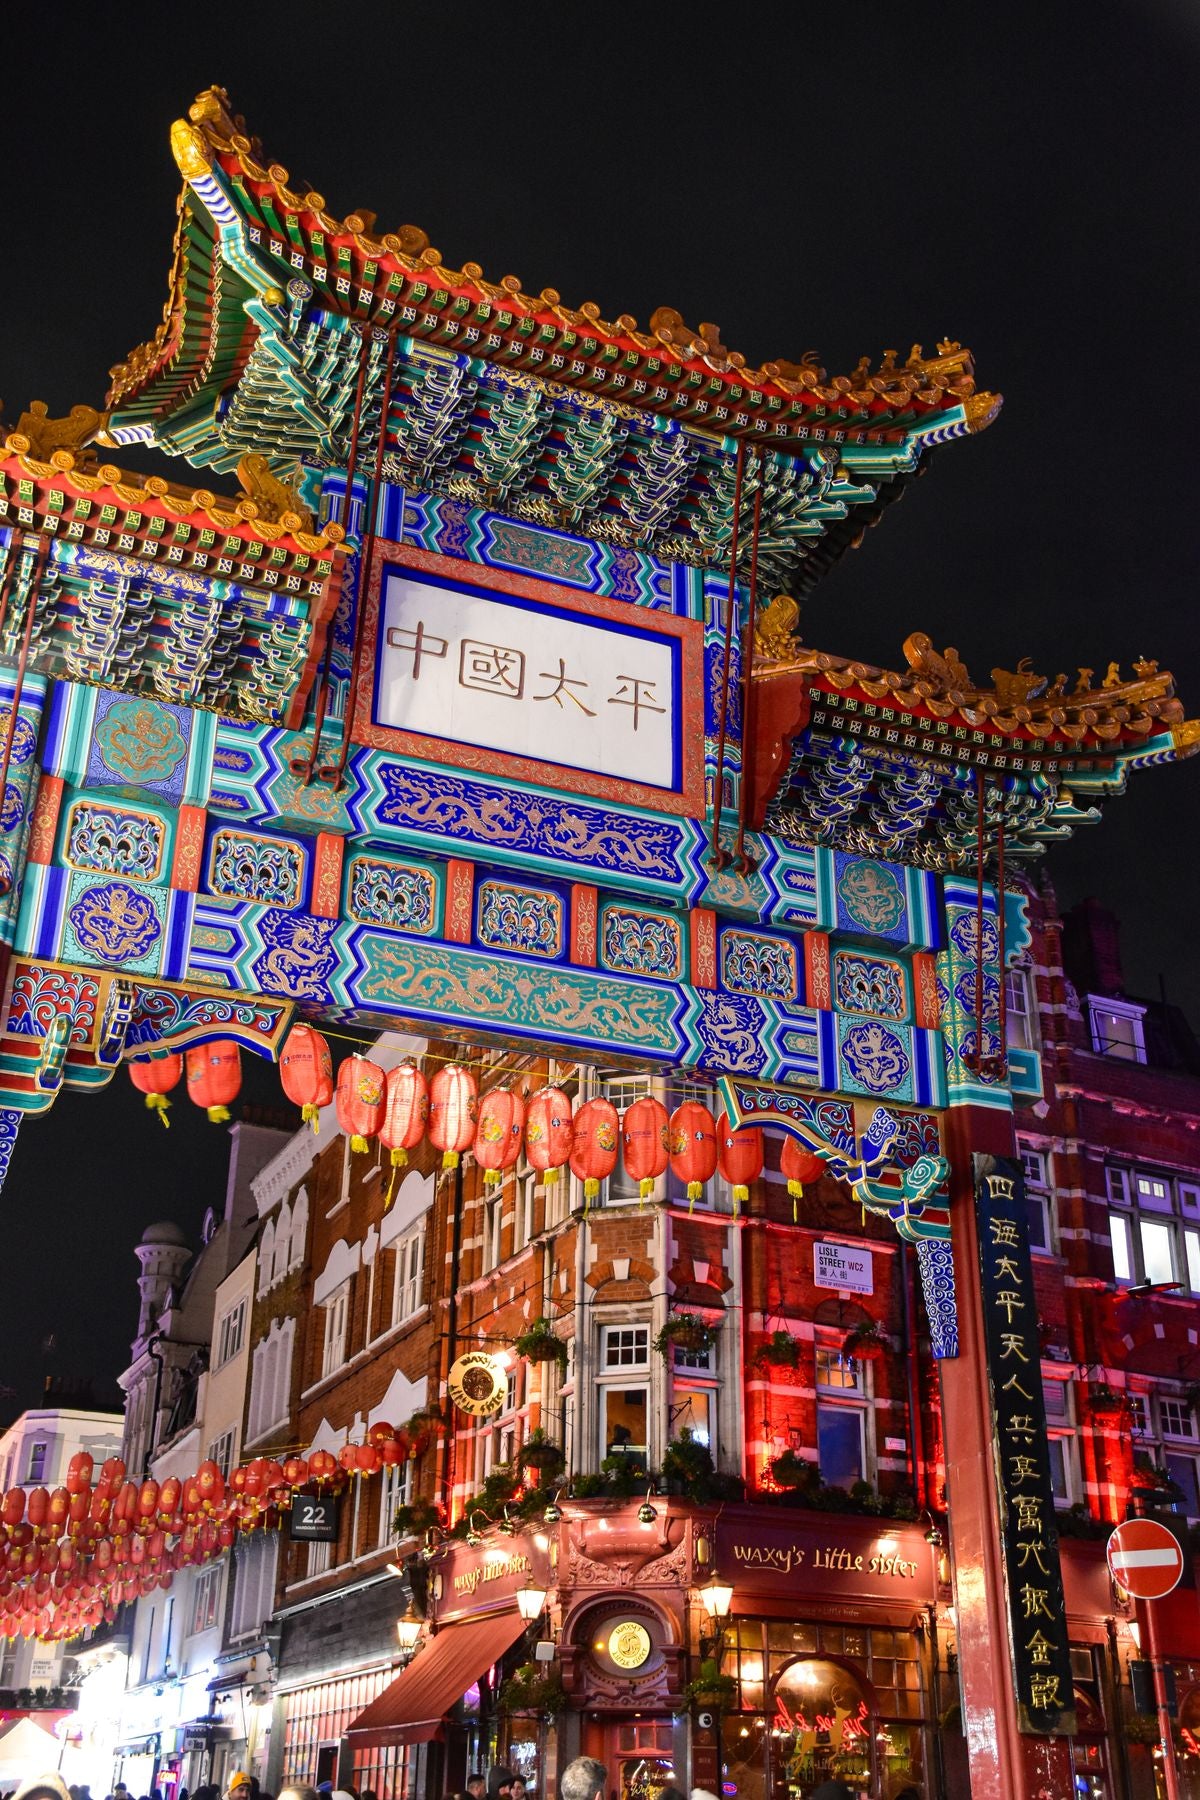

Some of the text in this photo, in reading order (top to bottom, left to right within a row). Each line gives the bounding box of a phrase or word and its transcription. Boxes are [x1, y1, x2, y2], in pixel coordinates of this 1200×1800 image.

[387, 621, 667, 732] 中國太平
[819, 1246, 838, 1257] LISLE
[819, 1257, 864, 1272] STREET WC2
[303, 1506, 325, 1524] 22
